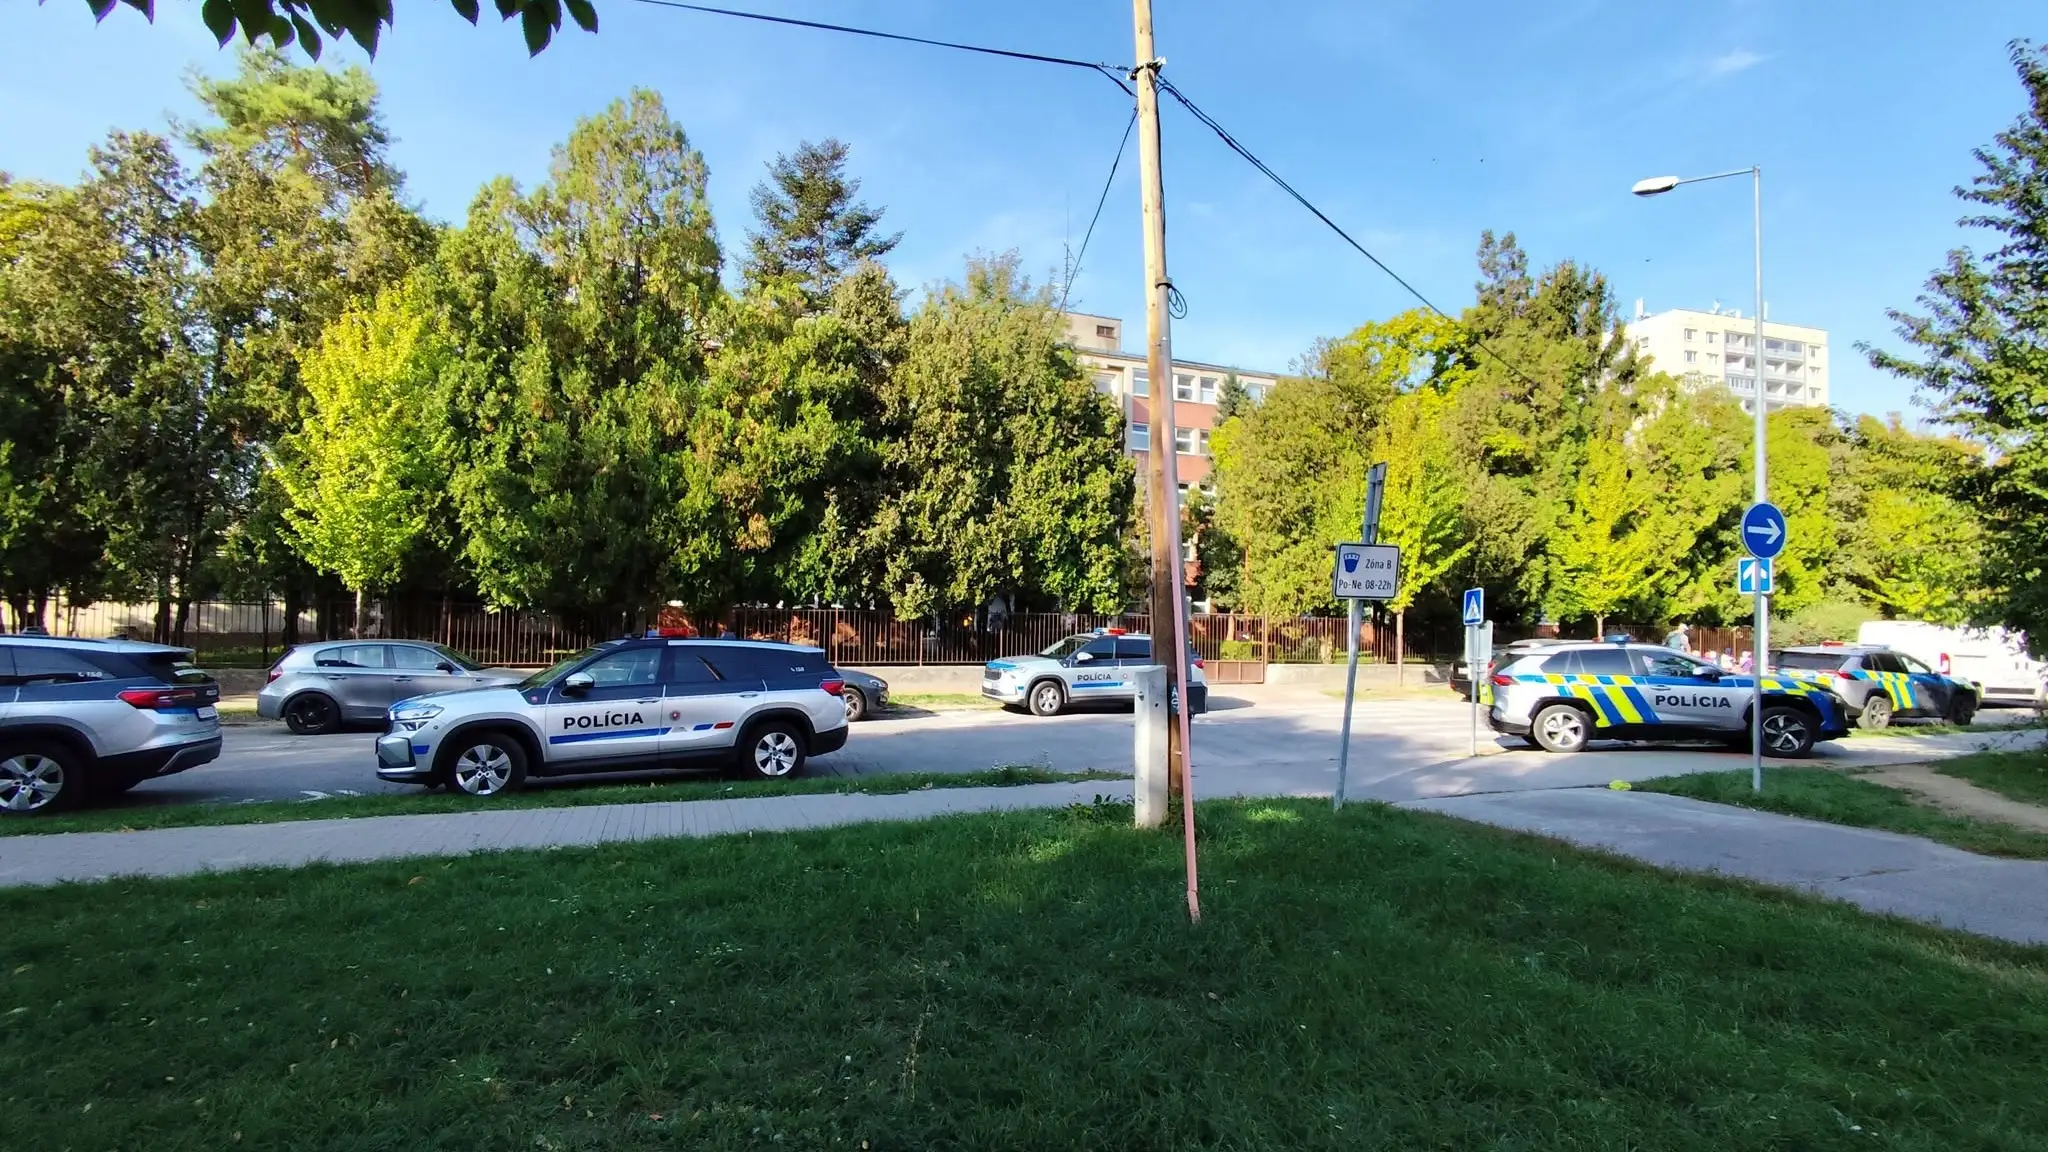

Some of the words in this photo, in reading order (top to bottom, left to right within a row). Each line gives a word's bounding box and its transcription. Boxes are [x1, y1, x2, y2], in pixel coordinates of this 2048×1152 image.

[1365, 558, 1384, 569] Zóna
[1387, 560, 1392, 569] B
[1338, 579, 1362, 590] Po-Ne
[1365, 580, 1392, 590] 08-22h
[1077, 672, 1112, 682] POLÍCIA
[1655, 693, 1732, 708] POLÍCIA
[563, 710, 644, 730] POLÍCIA
